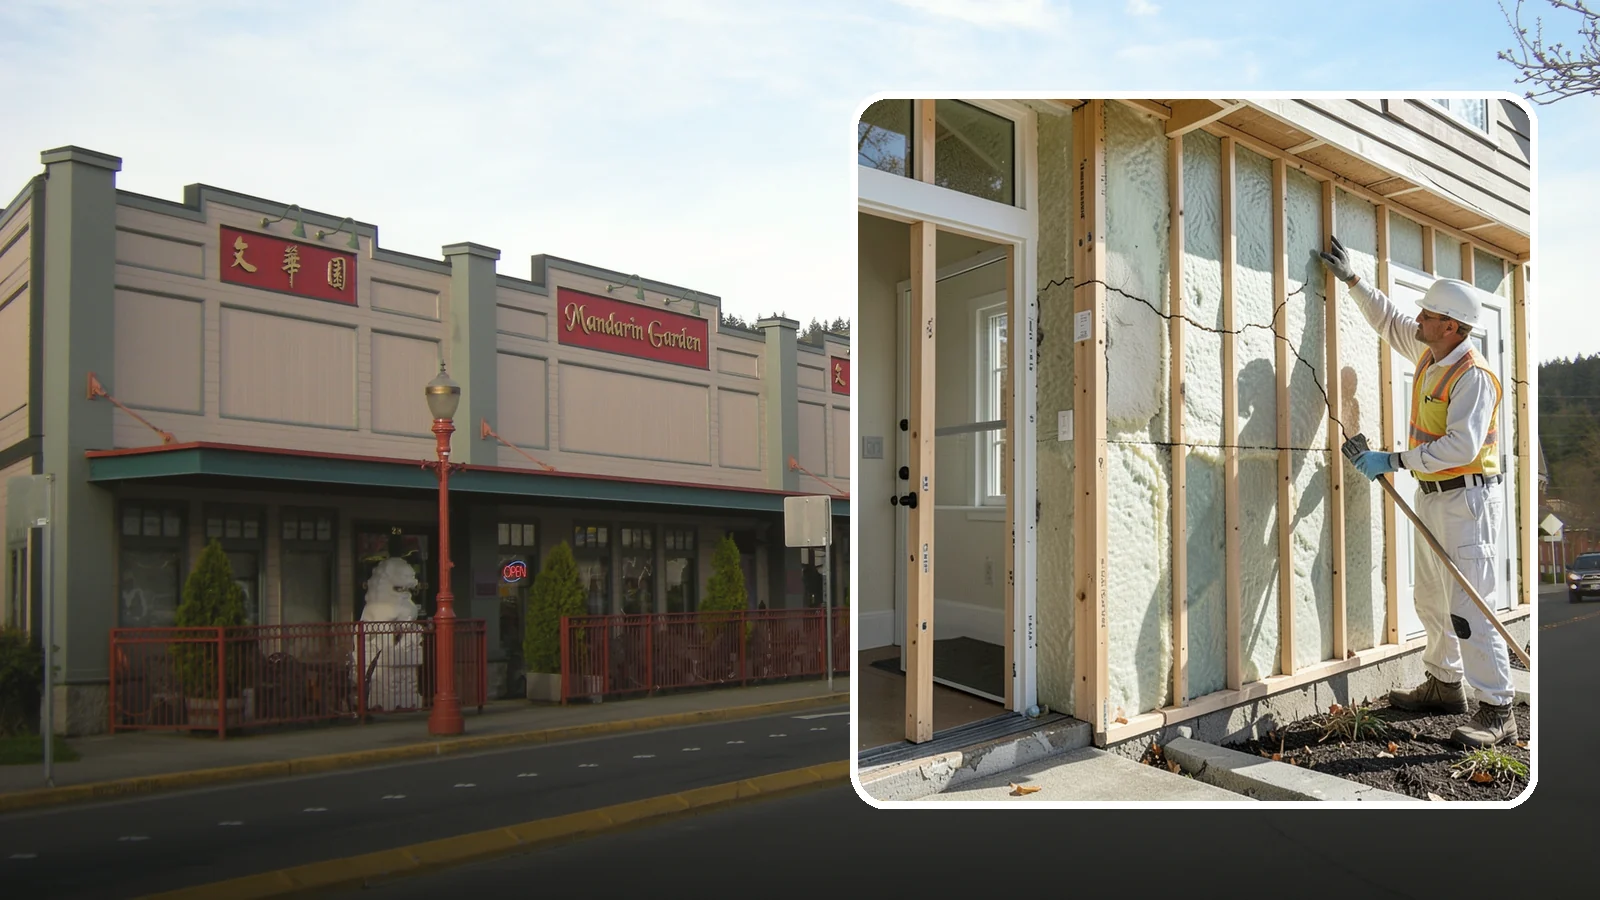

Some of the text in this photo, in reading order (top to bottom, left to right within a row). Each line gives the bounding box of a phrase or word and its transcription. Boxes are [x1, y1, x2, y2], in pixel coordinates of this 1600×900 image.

[565, 303, 701, 352] Mandarin Garden
[503, 565, 527, 578] OPEN
